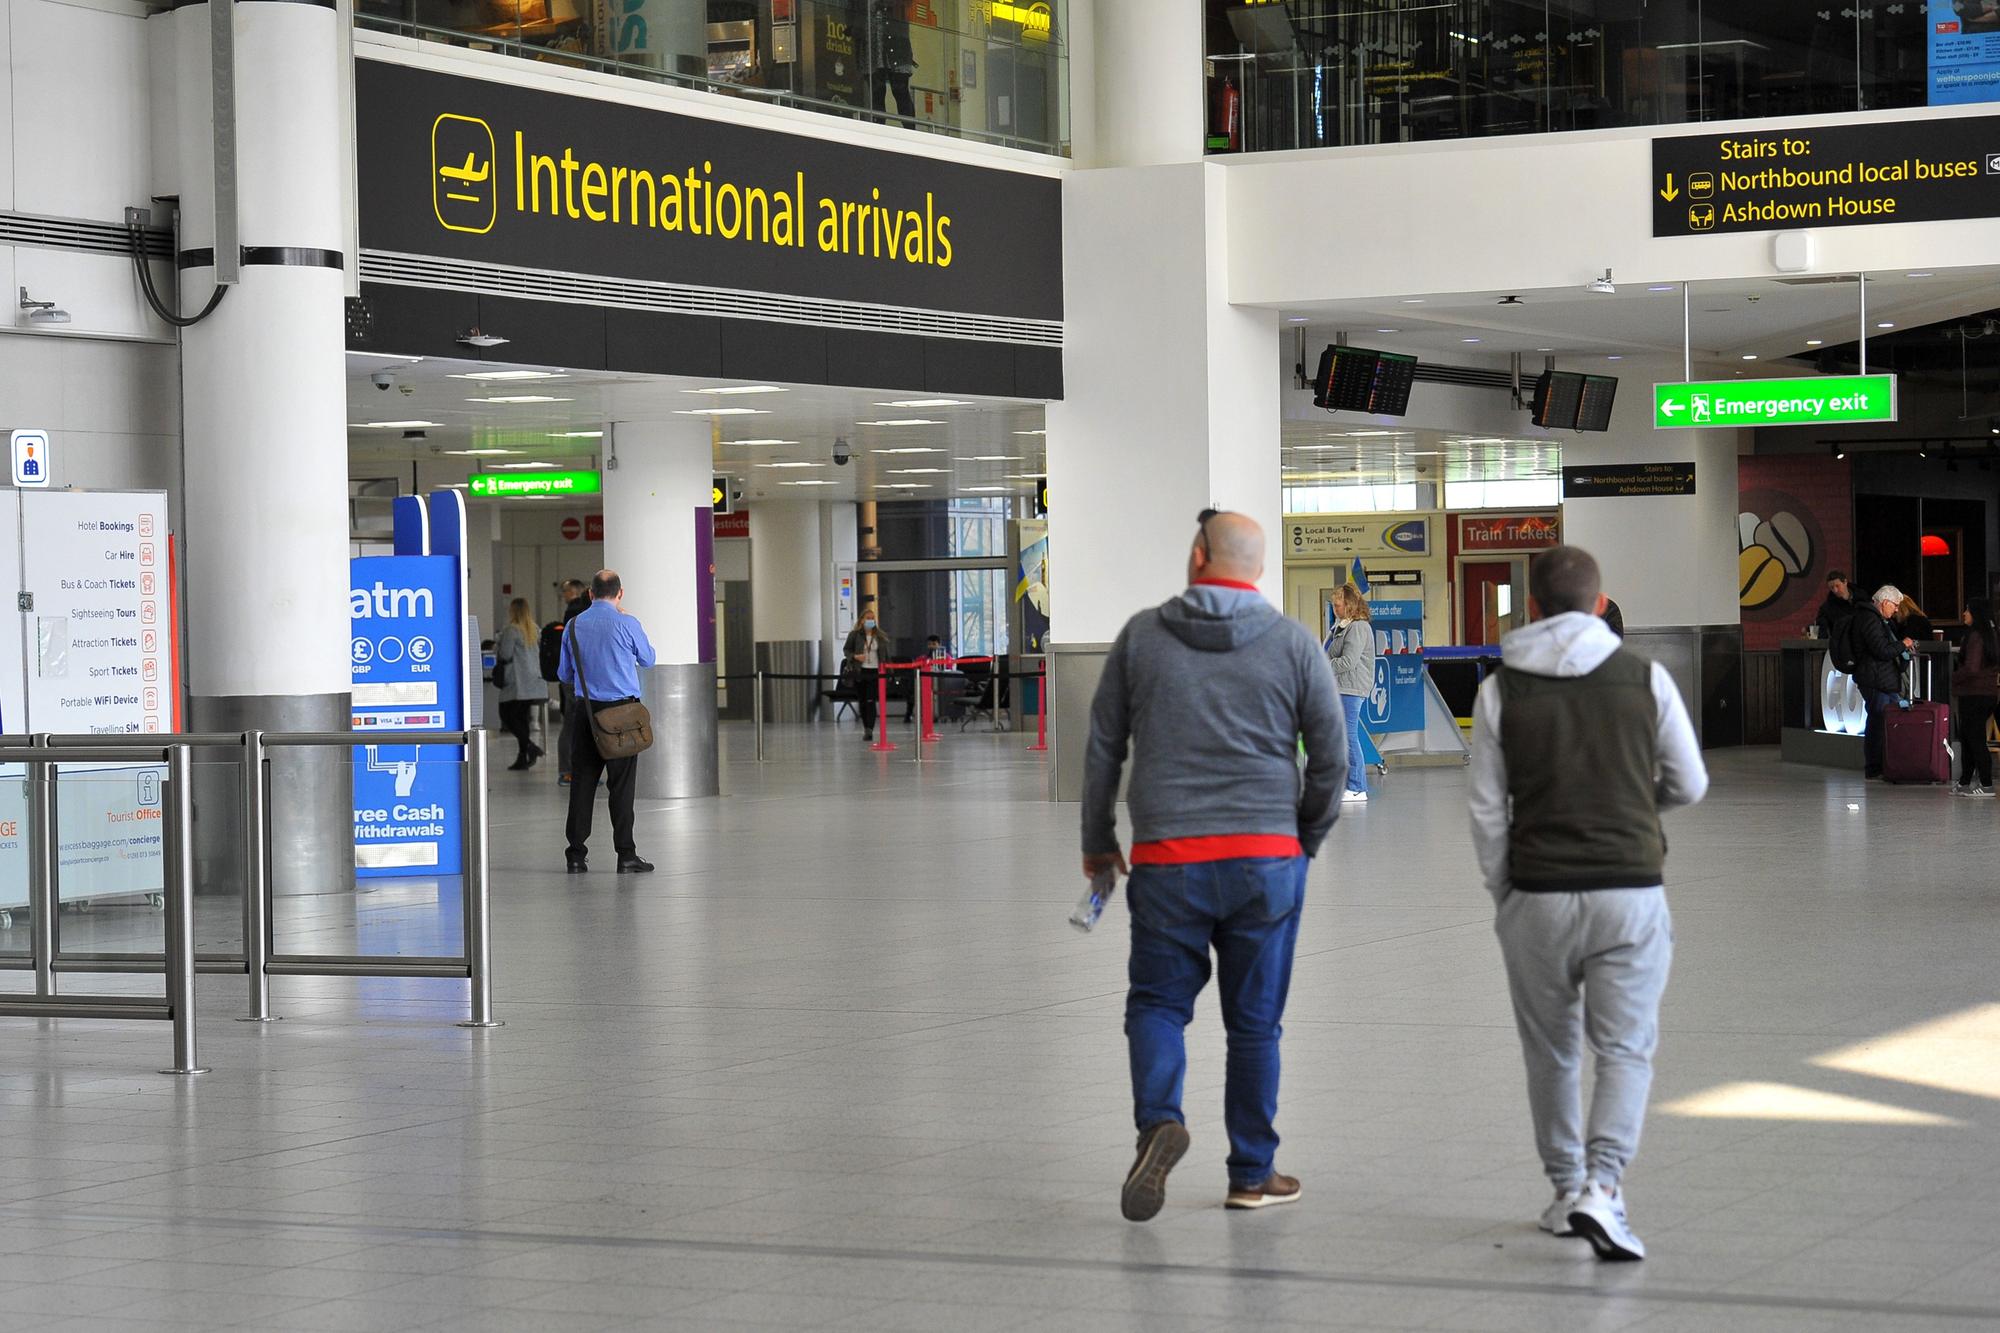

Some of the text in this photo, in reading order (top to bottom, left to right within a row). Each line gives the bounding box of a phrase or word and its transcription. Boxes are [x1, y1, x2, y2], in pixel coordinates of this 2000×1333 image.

[1720, 138, 1811, 160] Stairs to:
[1720, 163, 1852, 191] Northbound
[1859, 160, 1908, 182] local
[1915, 158, 1978, 180] buses
[514, 130, 953, 267] International arrivals
[1722, 196, 1896, 223] Ashdown House
[1715, 393, 1868, 417] Emergency exit
[1644, 465, 1663, 473] Stairs
[498, 478, 573, 492] Emergency exit
[1594, 476, 1635, 484] Northbound
[1636, 475, 1653, 483] local
[1654, 475, 1673, 483] buses
[78, 521, 134, 533] Hotel Bookings
[1327, 526, 1341, 534] Bus
[1342, 525, 1365, 533] Travel
[1467, 525, 1557, 541] Train Tickets
[105, 551, 135, 560] Car Hire
[61, 580, 136, 589] Bus & Coach Tickets
[350, 581, 434, 618] atm
[72, 608, 136, 620] Sightseeing Tours
[72, 637, 137, 648] Attraction Tickets
[89, 666, 138, 678] Sport Tickets
[352, 664, 431, 673] GBP EUR
[60, 695, 138, 707] Portable WiFi Device
[126, 722, 139, 732] SIM
[107, 808, 161, 823] Tourist Office
[354, 804, 444, 822] ree Cash
